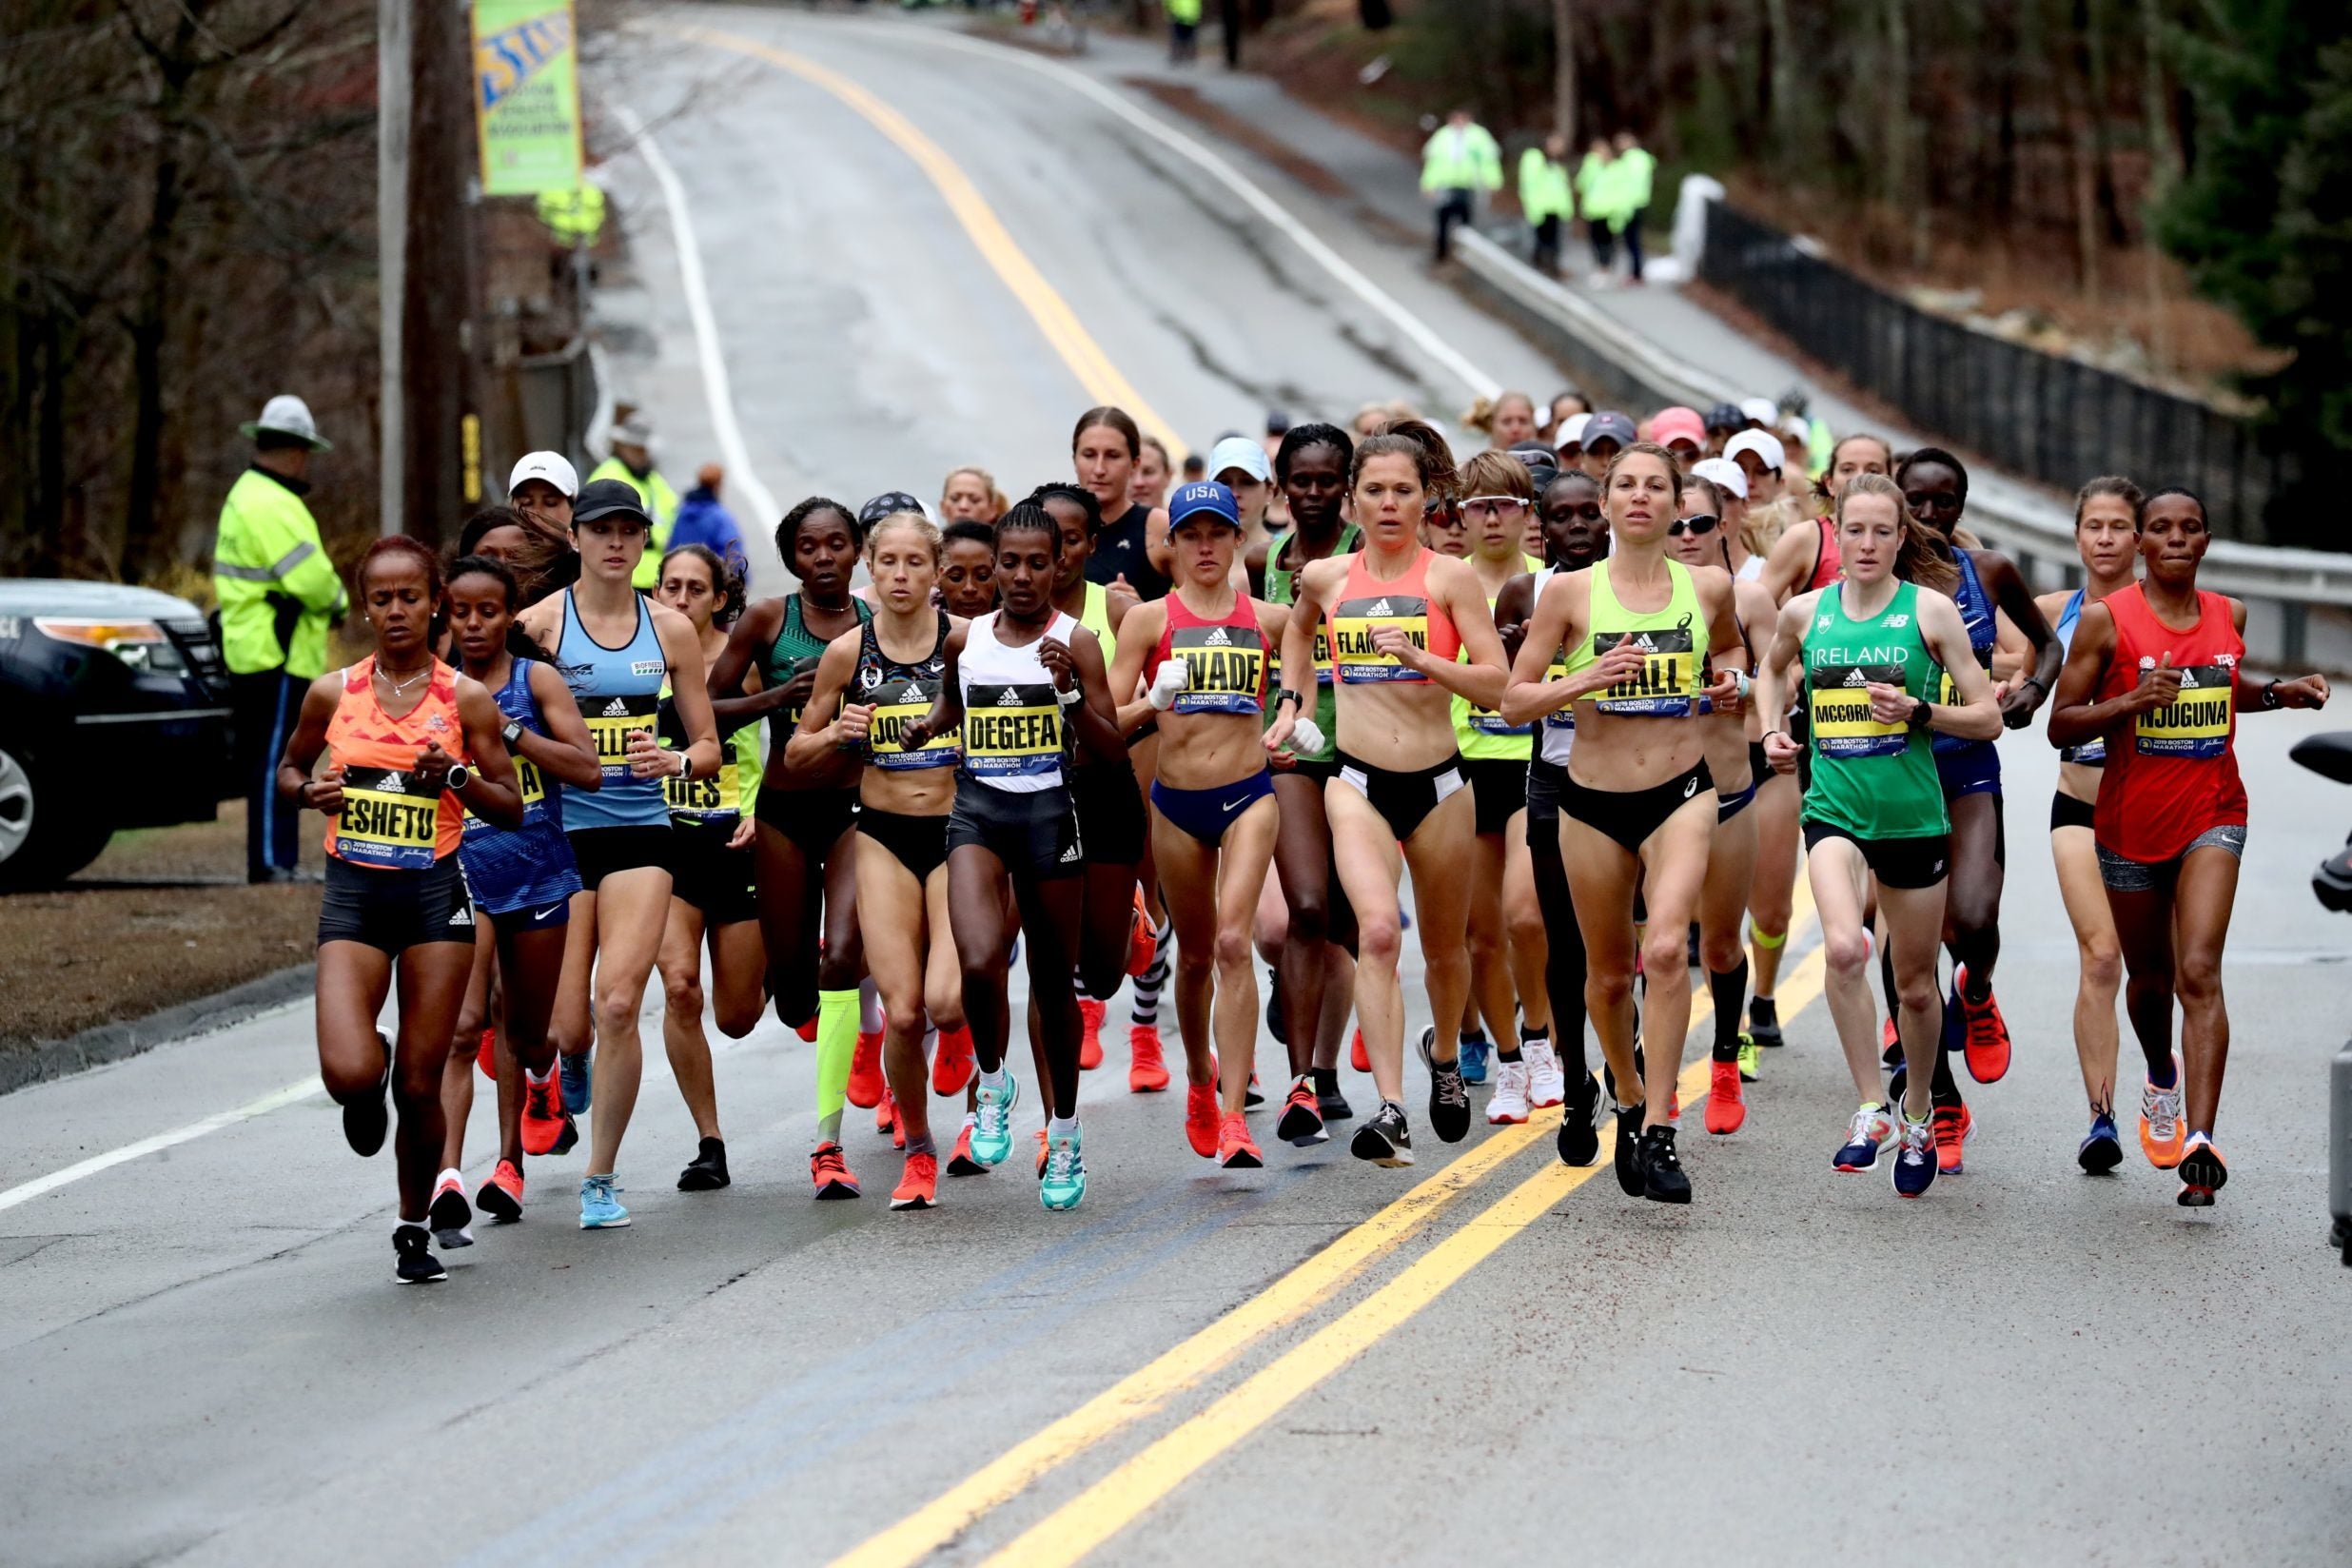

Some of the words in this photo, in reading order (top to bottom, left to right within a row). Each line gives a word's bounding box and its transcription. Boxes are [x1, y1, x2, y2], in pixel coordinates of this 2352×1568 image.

[1186, 486, 1220, 501] USA
[1337, 631, 1425, 654] FLANN
[1812, 646, 1909, 667] IRELAND
[1175, 652, 1261, 694] WADE
[898, 695, 928, 703] adidas
[1815, 704, 1876, 723] MCCORM
[2140, 700, 2227, 728] NJUGUNA
[970, 714, 1058, 750] DEGEFA
[376, 783, 406, 794] adidas
[340, 796, 435, 841] ESHETU
[352, 847, 394, 857] MARATHON
[365, 842, 393, 852] BOSTON
